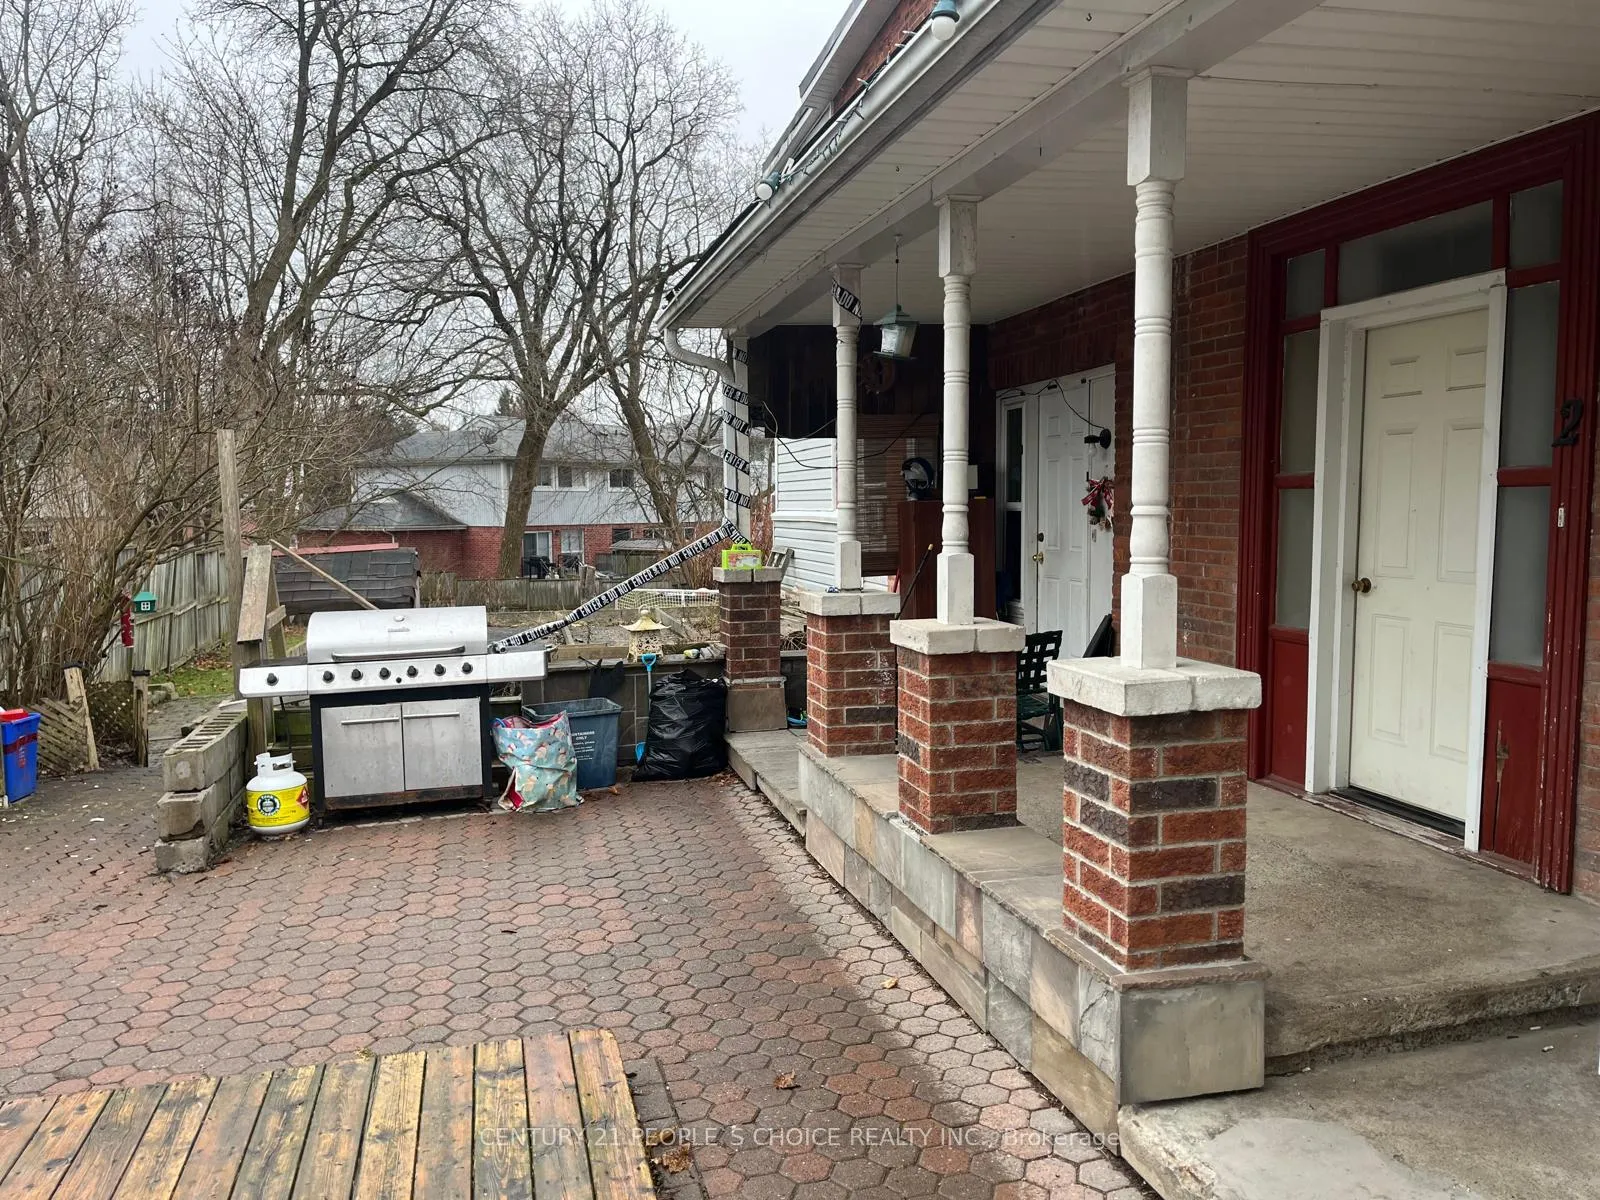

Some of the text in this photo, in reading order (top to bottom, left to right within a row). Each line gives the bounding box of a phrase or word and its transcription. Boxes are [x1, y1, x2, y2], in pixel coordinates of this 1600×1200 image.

[839, 290, 854, 309] DO
[731, 418, 746, 432] NOT
[1551, 398, 1583, 447] 2
[724, 451, 745, 470] ENTER
[728, 490, 739, 503] DO
[510, 635, 525, 647] NOT
[526, 627, 549, 641] ENTER
[565, 610, 580, 622] NOT
[581, 599, 602, 616] ENTER
[608, 589, 618, 601] DO
[618, 581, 632, 595] NOT
[633, 570, 654, 587] ENTER
[659, 563, 669, 573] DO
[669, 555, 682, 567] NOT
[682, 541, 704, 559] ENTER
[708, 534, 719, 544] DO
